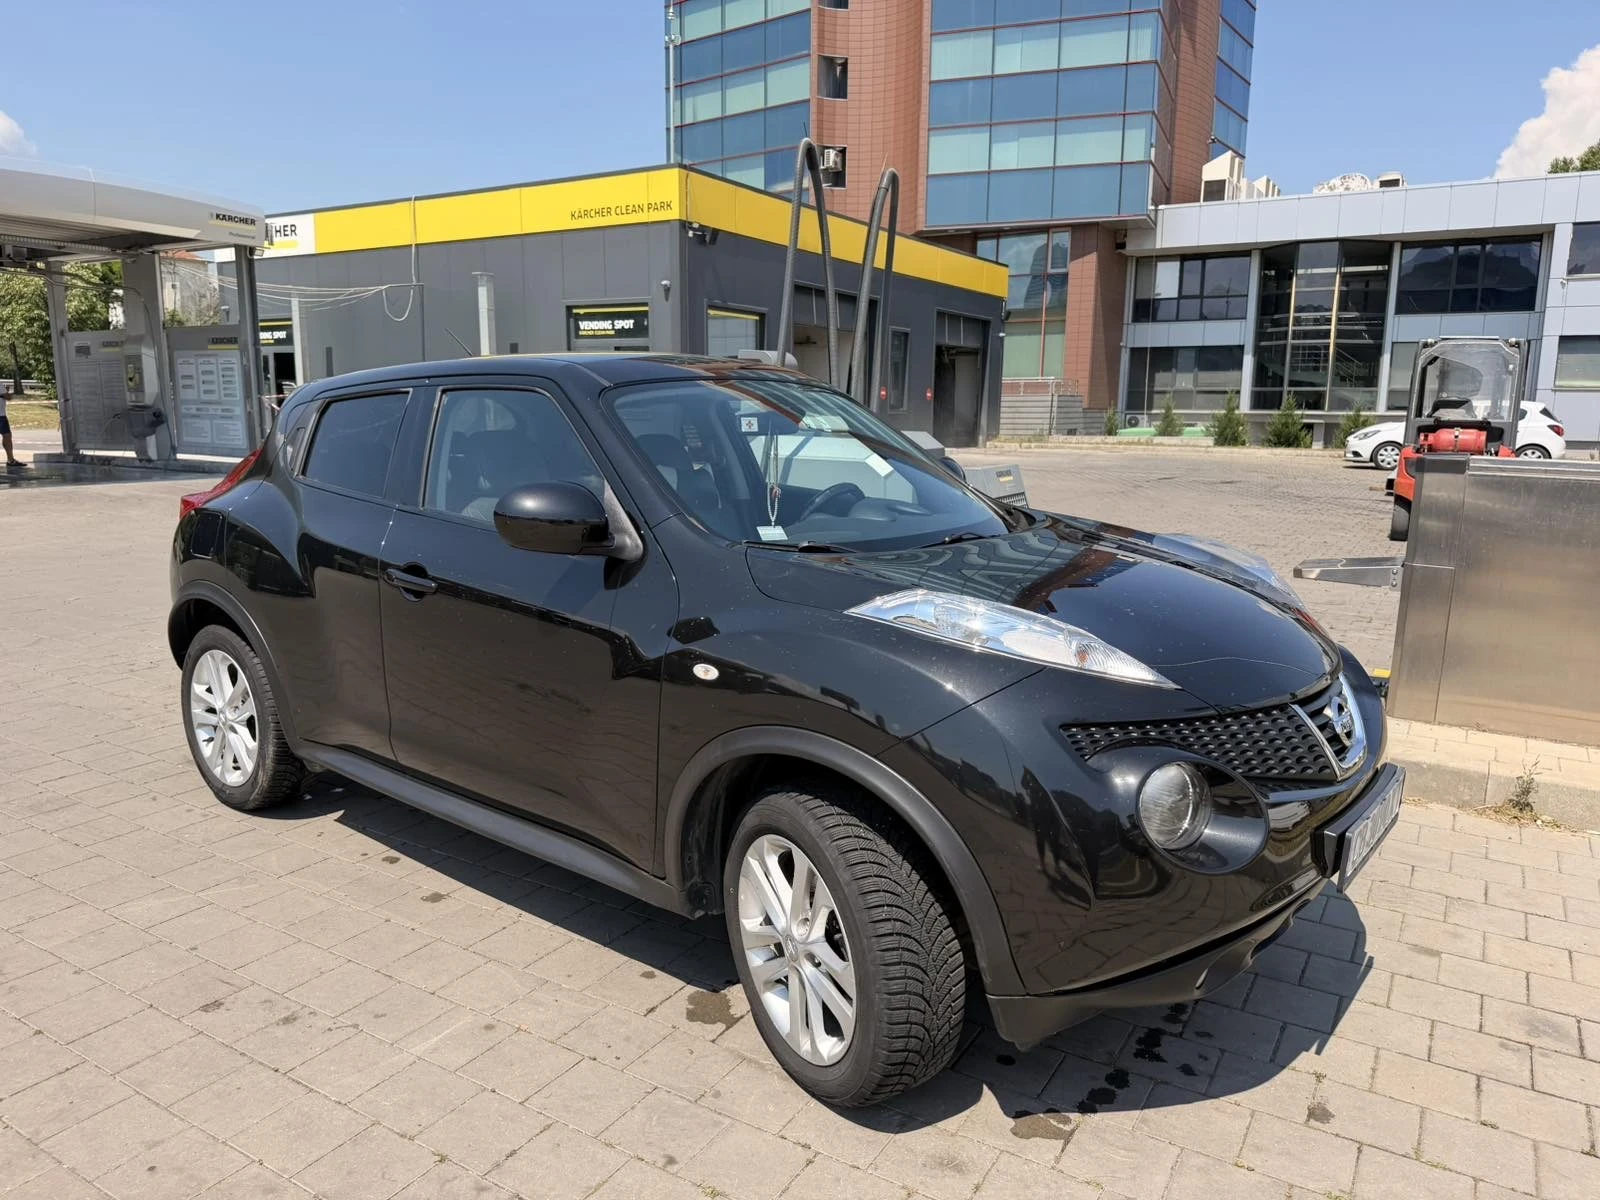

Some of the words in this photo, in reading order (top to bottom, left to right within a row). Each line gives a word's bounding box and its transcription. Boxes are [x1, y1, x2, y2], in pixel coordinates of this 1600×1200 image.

[571, 206, 612, 220] KÄRCHER
[614, 203, 645, 216] CLEAN
[647, 200, 673, 213] PARK
[274, 223, 298, 238] HER
[579, 320, 613, 330] VENDING
[614, 319, 635, 330] SPOT
